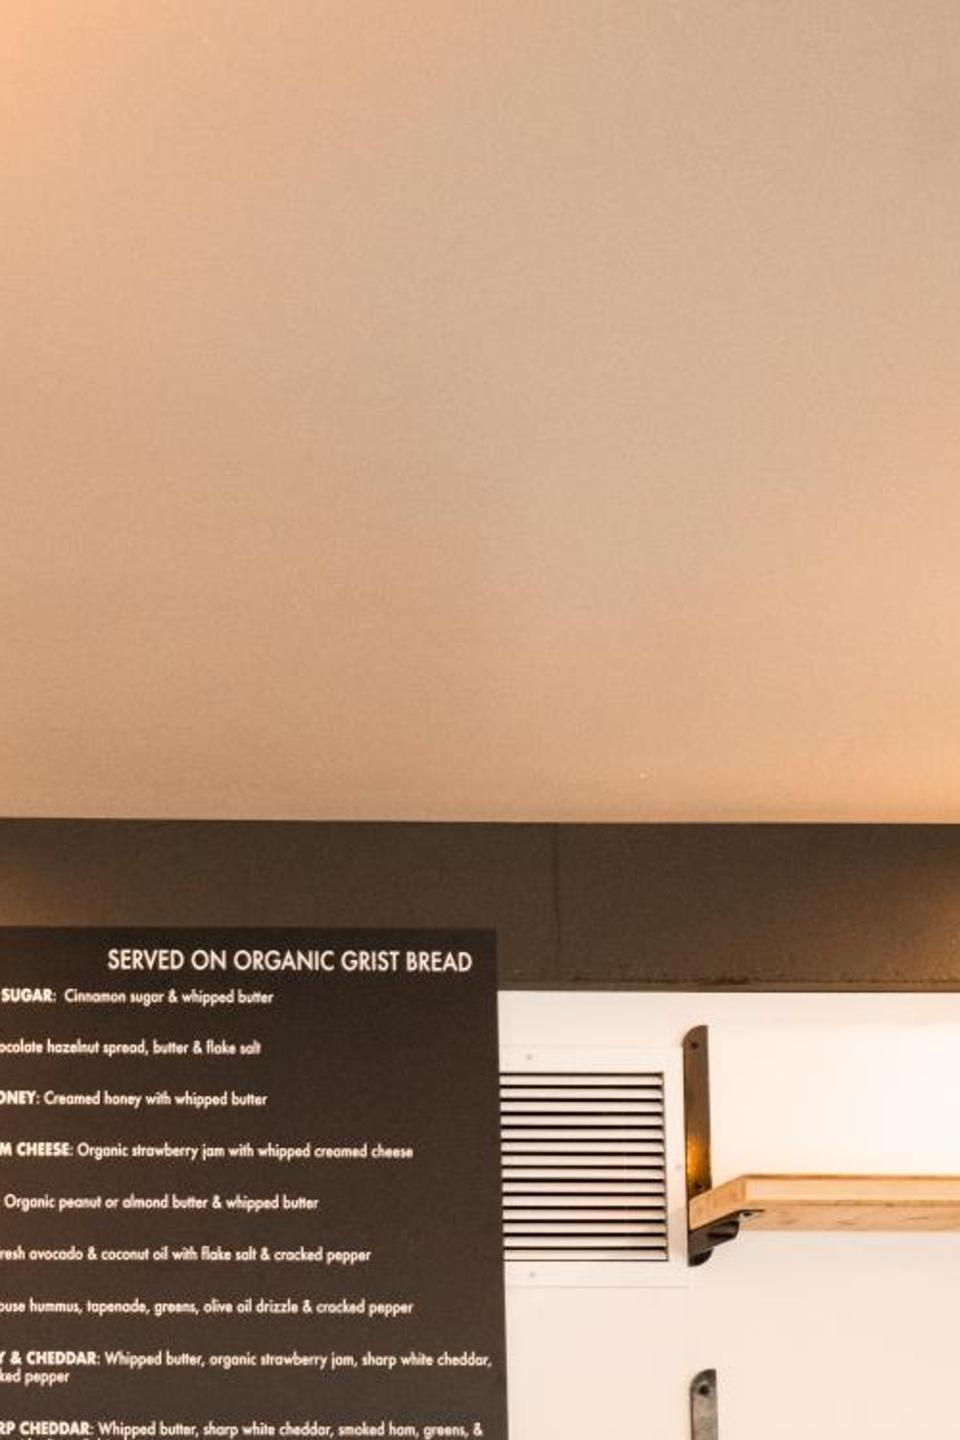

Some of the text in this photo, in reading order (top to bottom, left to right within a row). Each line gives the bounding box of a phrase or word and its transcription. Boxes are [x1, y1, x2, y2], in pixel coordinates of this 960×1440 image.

[108, 949, 472, 972] SERVED ON ORGANIC GRIST BREAD
[1, 988, 56, 1002] SUGAR:
[64, 988, 126, 1003] Cinnamon
[130, 993, 164, 1006] sugar
[168, 989, 178, 1003] &
[182, 989, 234, 1006] whipped
[238, 989, 274, 1003] butter
[44, 1090, 100, 1105] Creamed
[104, 1090, 142, 1108] honey
[145, 1091, 171, 1104] with
[174, 1091, 227, 1109] whipped
[231, 1091, 267, 1106] butter
[4, 1194, 55, 1212] Organic
[59, 1196, 102, 1212] peanut
[105, 1199, 119, 1208] or
[122, 1194, 169, 1208] almond
[172, 1194, 208, 1209] butter
[212, 1195, 222, 1209] &
[226, 1194, 279, 1212] whipped
[282, 1194, 319, 1209] butter
